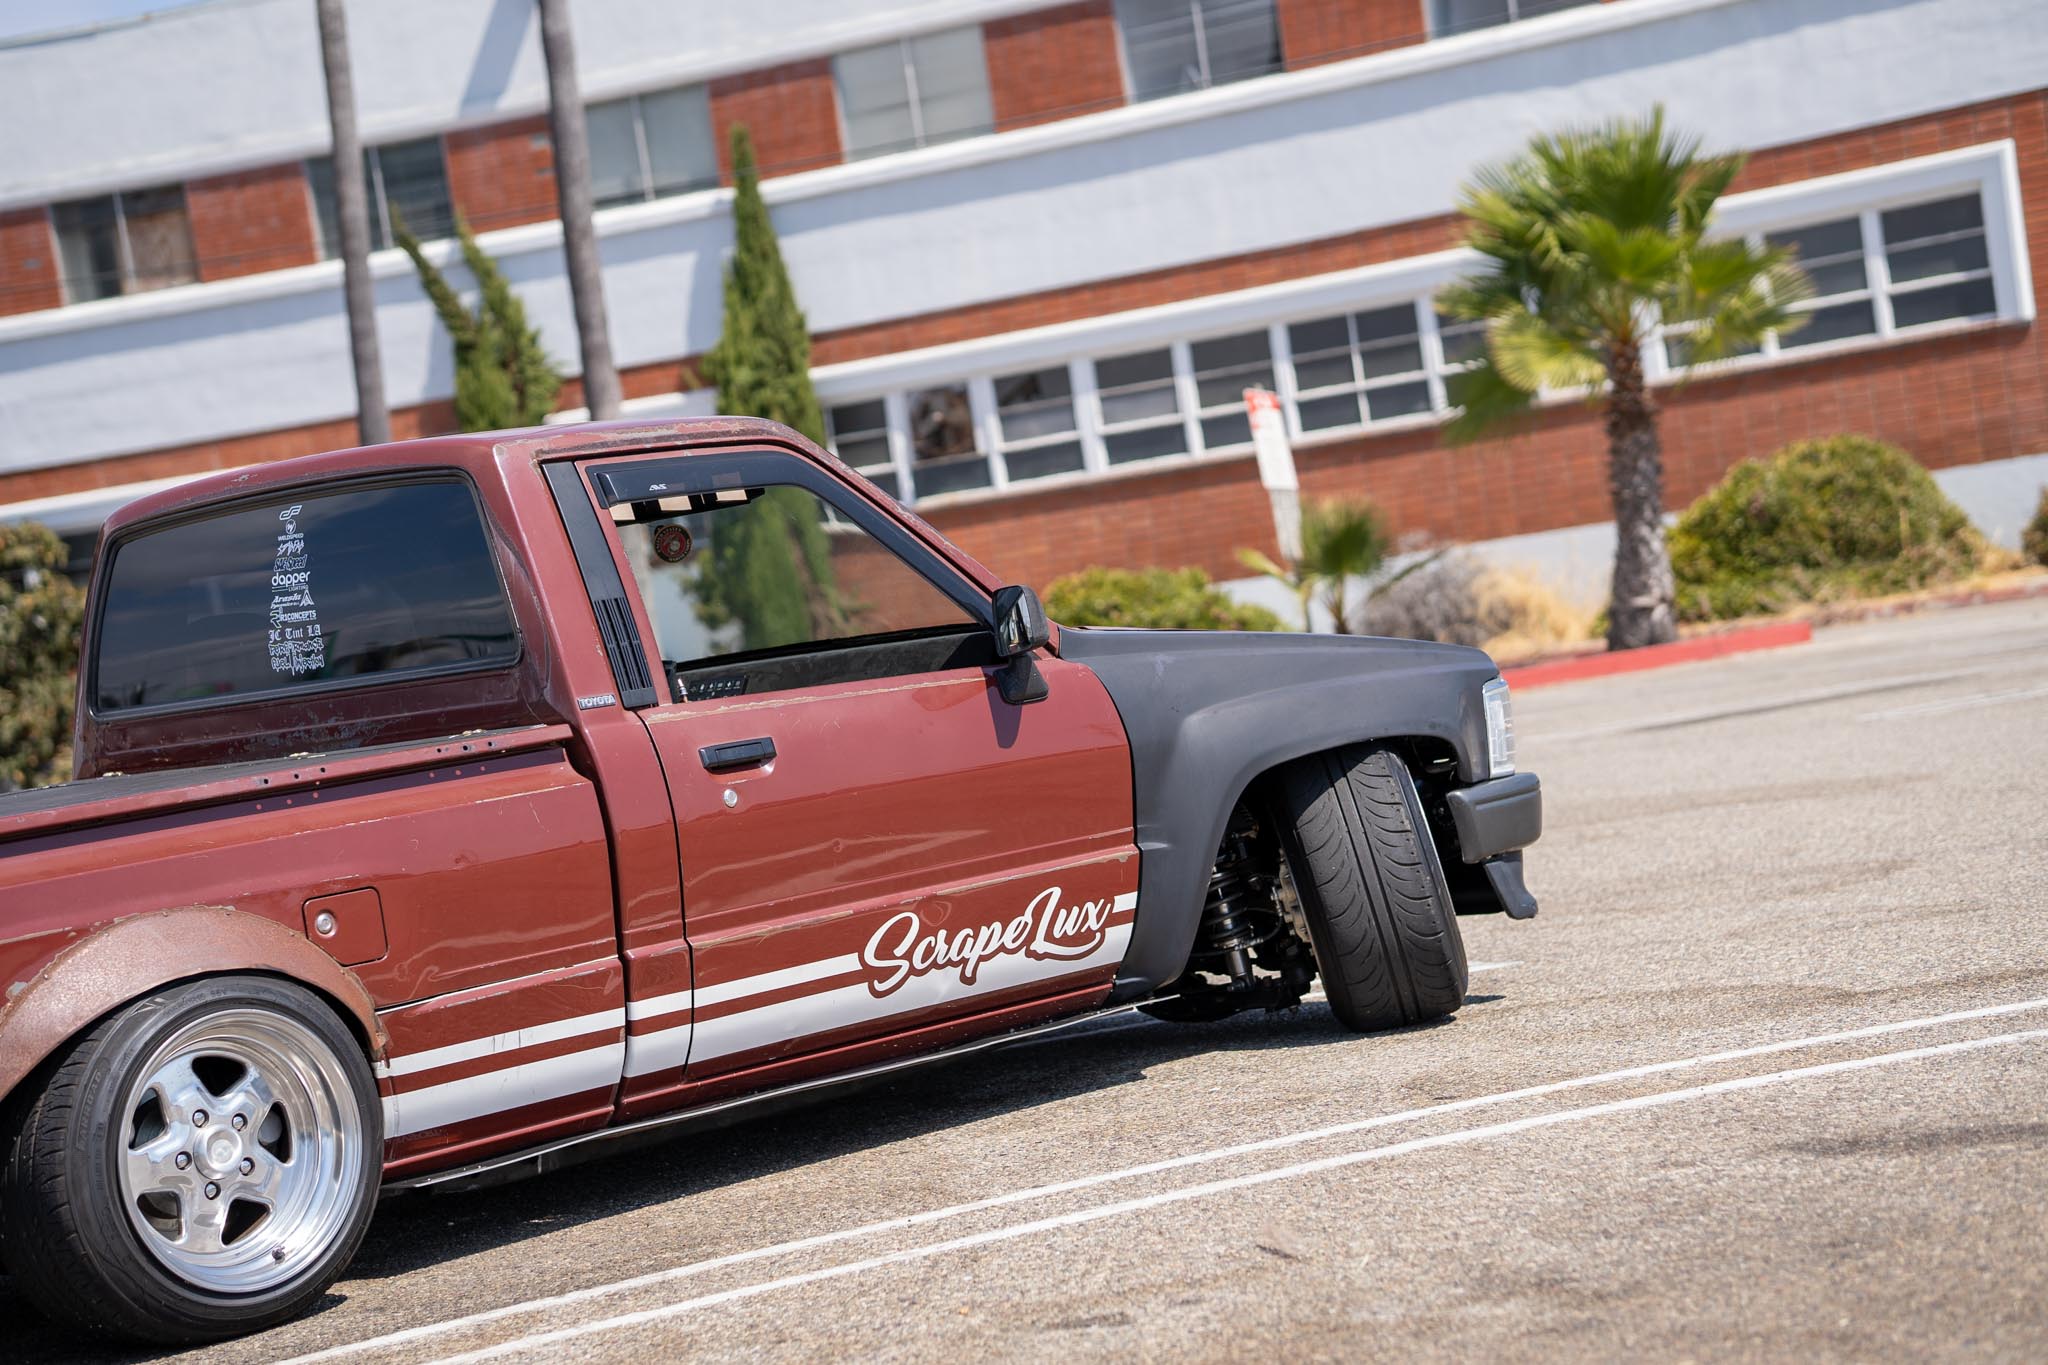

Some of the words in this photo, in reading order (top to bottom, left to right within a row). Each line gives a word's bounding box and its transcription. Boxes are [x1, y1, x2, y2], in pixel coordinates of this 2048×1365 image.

[272, 571, 310, 587] dapper
[285, 627, 304, 640] Tint
[306, 624, 321, 637] LA
[579, 695, 616, 707] TOYOTA
[864, 886, 1111, 991] ScrapeLux
